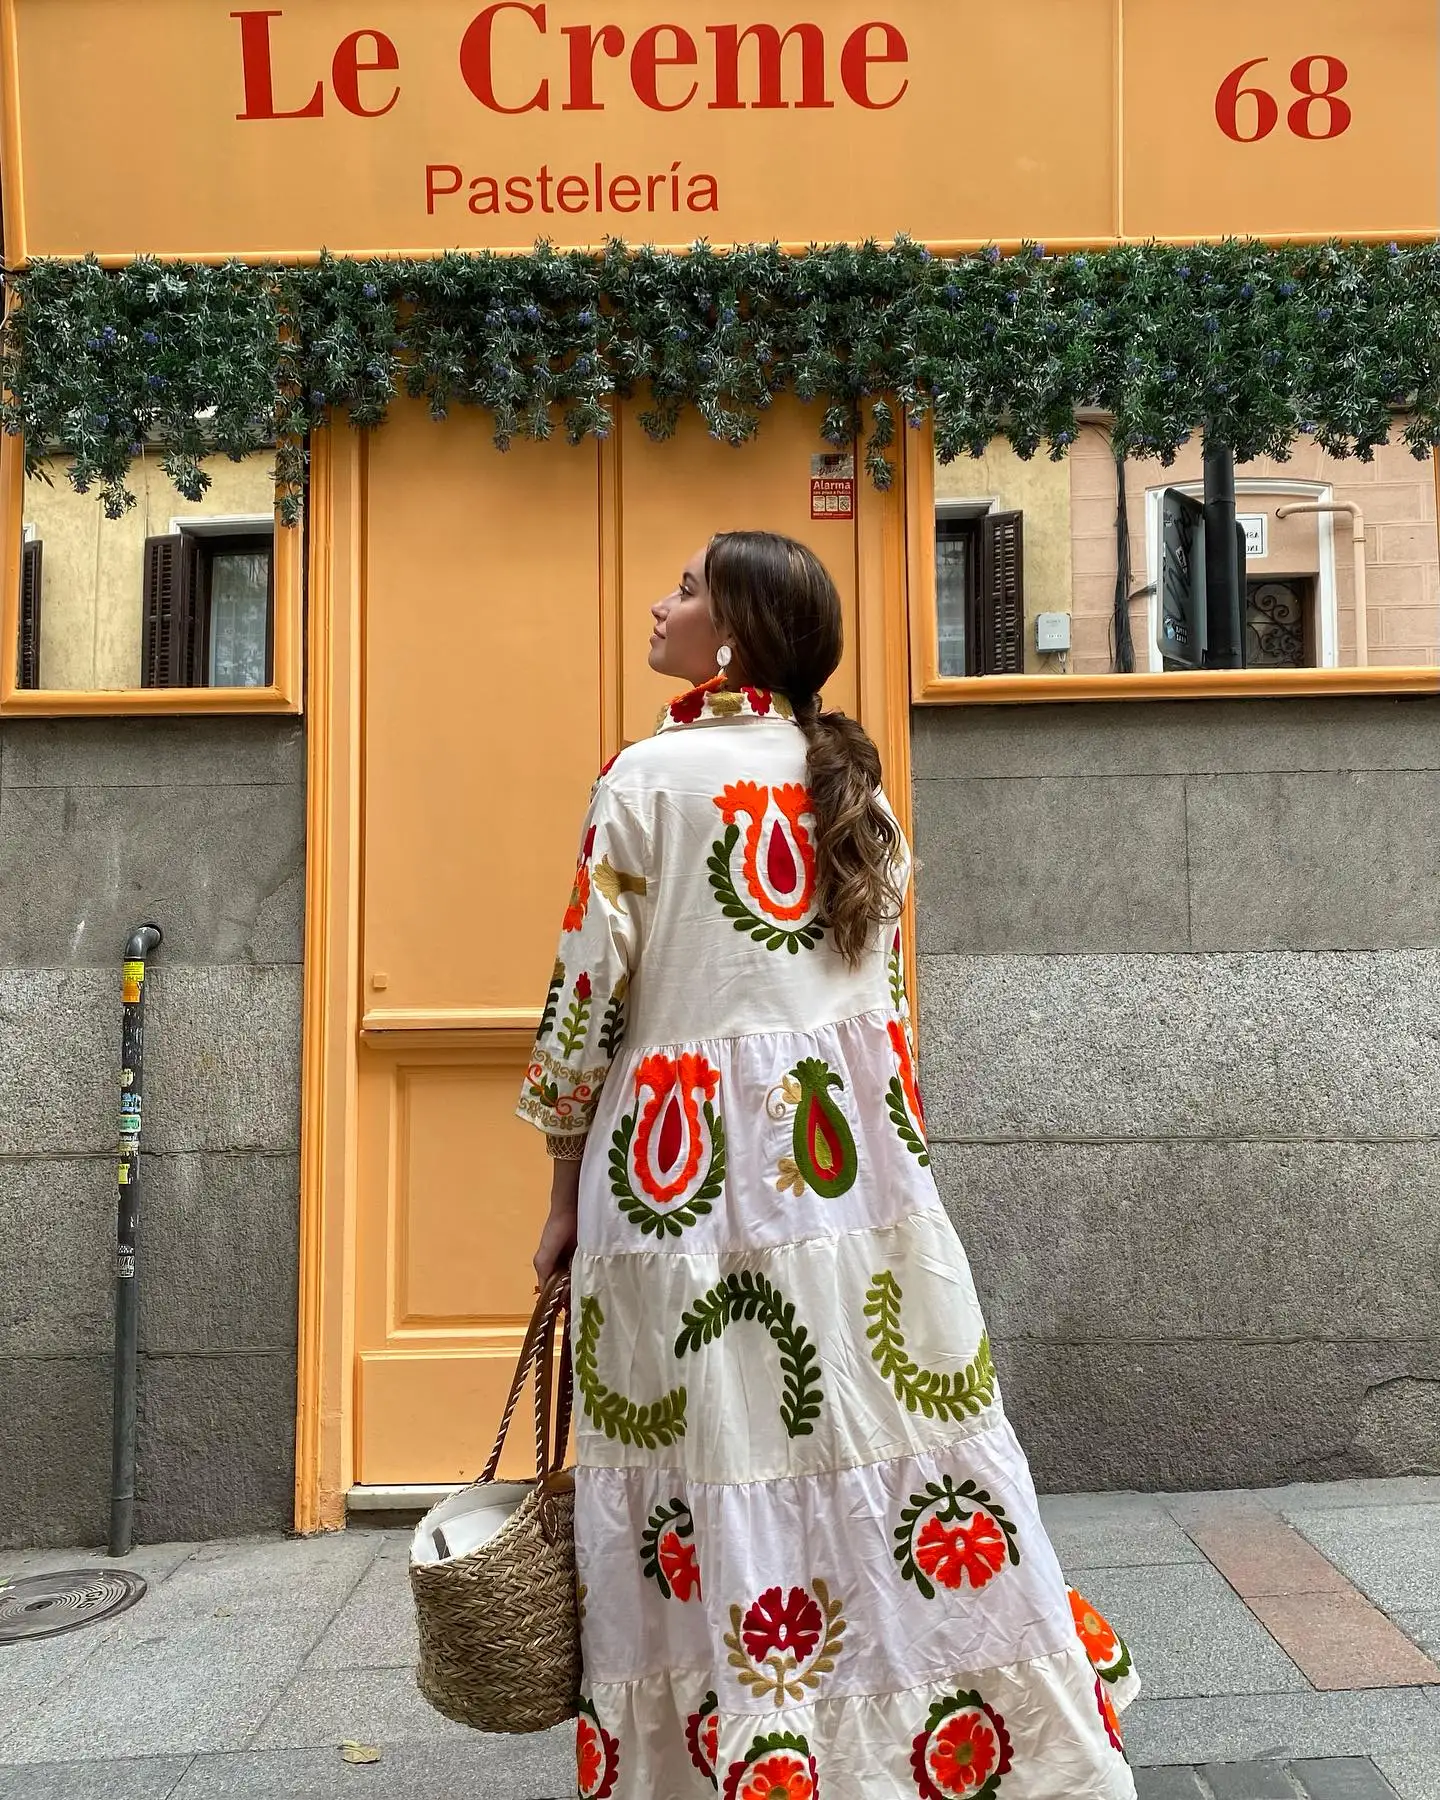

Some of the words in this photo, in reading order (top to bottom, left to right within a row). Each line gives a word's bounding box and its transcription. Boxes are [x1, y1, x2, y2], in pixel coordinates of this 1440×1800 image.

[230, 10, 401, 121] Le
[459, 1, 909, 115] Creme
[1214, 55, 1352, 143] 68
[425, 161, 719, 215] Pastelería
[813, 480, 851, 490] Alarma
